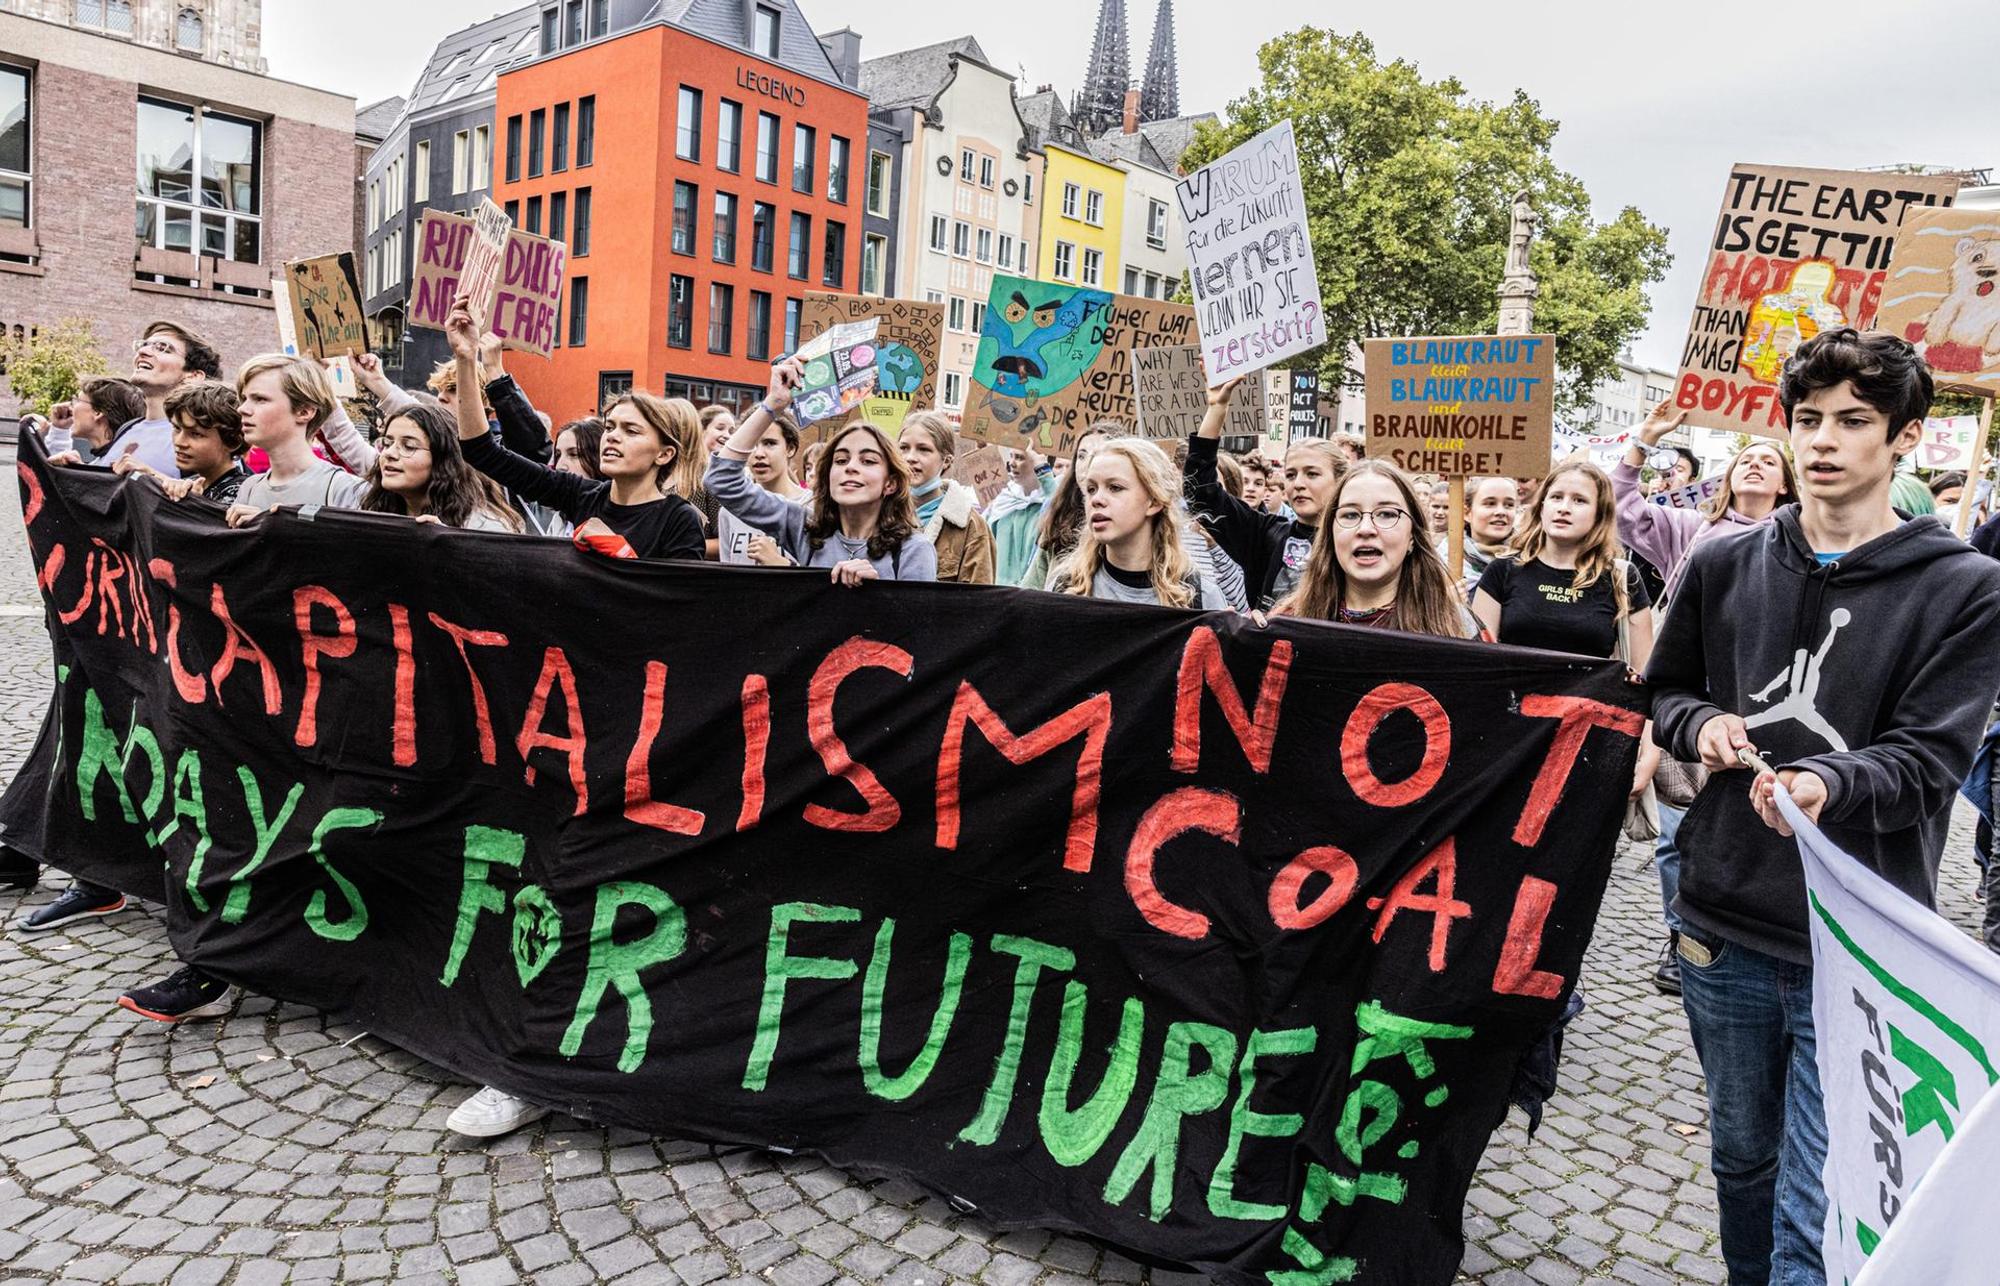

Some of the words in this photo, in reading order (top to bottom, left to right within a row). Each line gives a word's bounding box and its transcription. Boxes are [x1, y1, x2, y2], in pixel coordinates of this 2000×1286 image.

[736, 66, 806, 107] LEGEND
[1175, 130, 1296, 223] WARUM
[1730, 172, 1810, 216] THE
[1186, 230, 1210, 263] für
[1214, 217, 1237, 242] die
[1714, 213, 1754, 252] IS
[1755, 218, 1894, 270] GETTI
[422, 219, 475, 272] RID
[504, 237, 564, 300] DICKS
[1193, 221, 1306, 301] lernen
[414, 275, 459, 326] NO
[491, 291, 555, 353] CARS
[1200, 294, 1236, 339] WENN
[1239, 281, 1264, 322] IHR
[1274, 267, 1301, 310] SIE
[1695, 304, 1752, 338] THAN
[1212, 301, 1318, 374] zerstört?
[1135, 349, 1173, 371] WHY
[1182, 349, 1200, 367] TH
[1391, 338, 1543, 366] BLAUKRAUT
[1680, 333, 1745, 374] IMAGI
[1139, 373, 1167, 393] ARE
[1169, 372, 1190, 391] WE
[1273, 375, 1282, 389] IF
[1294, 375, 1316, 389] YOU
[1431, 364, 1471, 378] bleibt
[1141, 394, 1167, 412] FOR
[1171, 396, 1181, 411] A
[1239, 387, 1259, 408] WE
[1293, 392, 1313, 405] ACT
[1391, 376, 1542, 403] BLAUKRAUT
[1231, 408, 1267, 433] HAVE
[1289, 409, 1316, 422] ADULTS
[1428, 401, 1463, 414] und
[1269, 423, 1283, 441] WE
[1373, 414, 1528, 441] BRAUNKOHLE
[1538, 584, 1564, 595] GIRLS
[1564, 588, 1584, 598] BIE
[1545, 592, 1571, 604] BACK
[148, 557, 1112, 874] CAPITALISM
[1169, 625, 1647, 848] NOT
[741, 900, 1318, 1223] FUTURE
